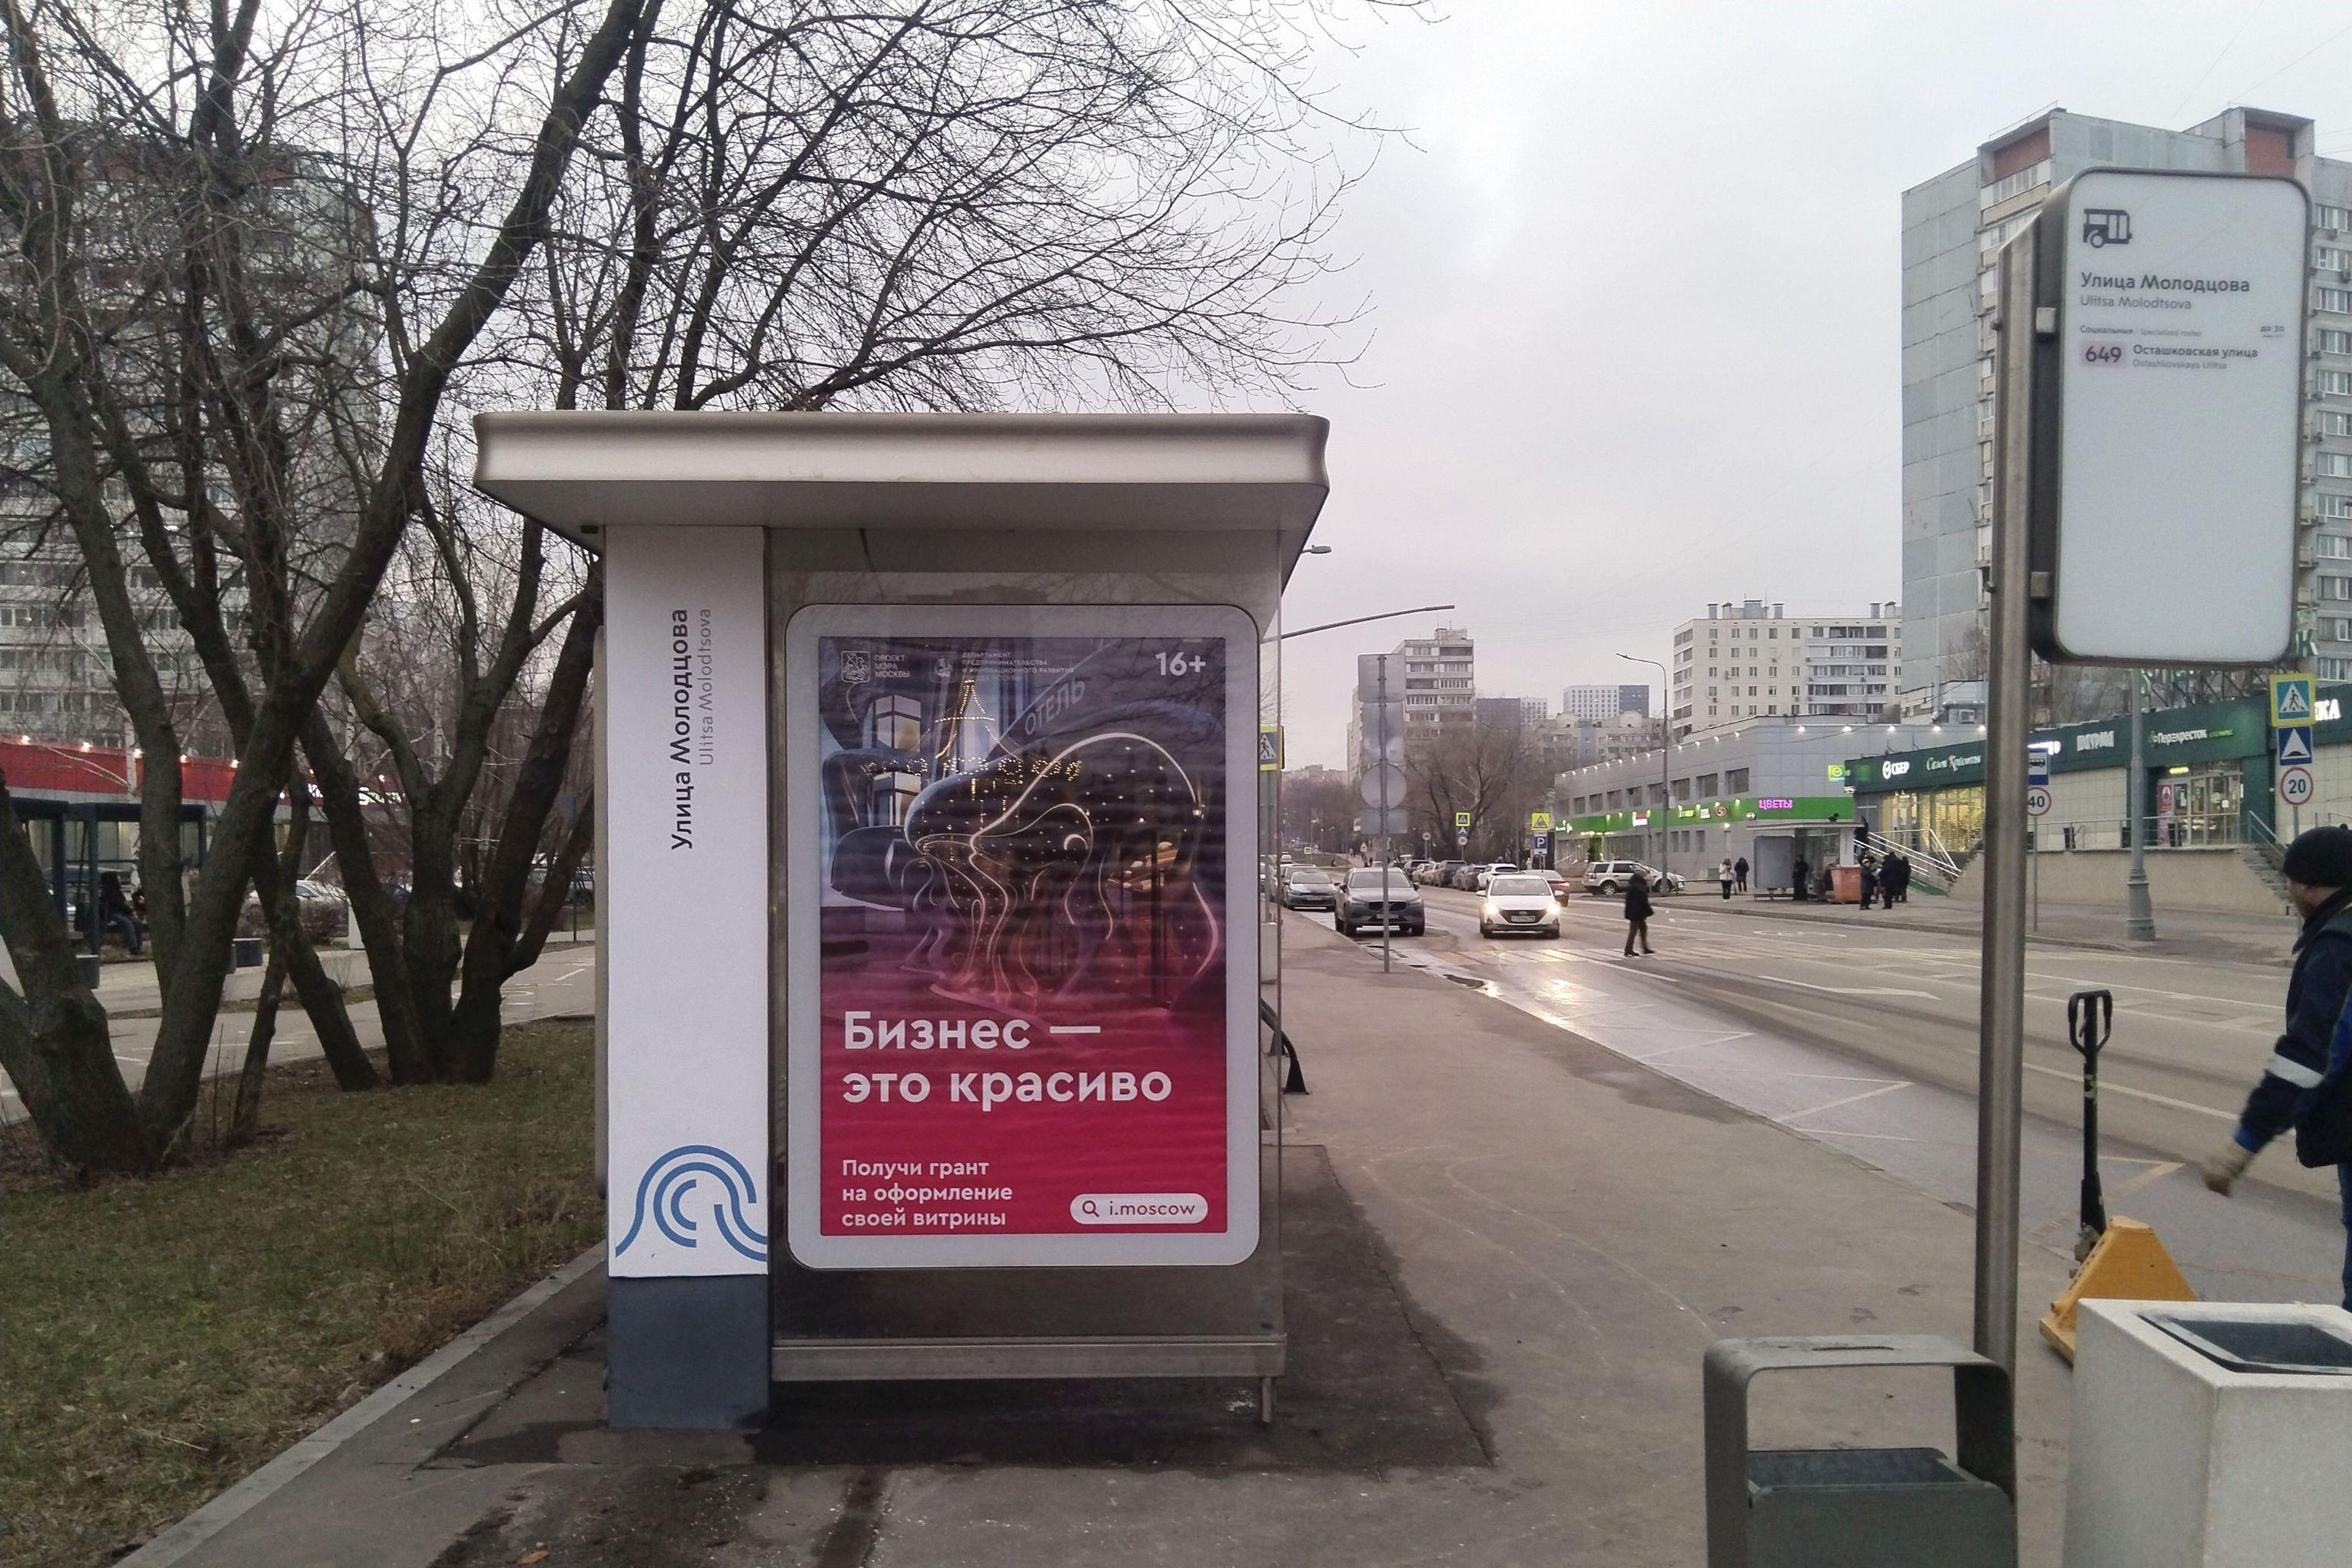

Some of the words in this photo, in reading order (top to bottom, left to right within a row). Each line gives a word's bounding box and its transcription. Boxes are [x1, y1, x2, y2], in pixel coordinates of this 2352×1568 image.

[2081, 271, 2135, 291] Улица
[2140, 274, 2250, 293] Молодцова
[2081, 294, 2114, 307] Ulitsa
[2118, 297, 2191, 309] Molodtsova
[2085, 346, 2121, 363] 649
[2133, 344, 2219, 357] Осташковская
[2221, 349, 2258, 359] улица
[697, 609, 713, 711] Molodtsova
[1155, 652, 1206, 676] 16+
[670, 610, 693, 764] Молодцова
[1025, 679, 1085, 735] ОТЕЛЬ
[699, 716, 714, 765] Ulitsa
[2288, 779, 2307, 794] 20
[671, 772, 694, 849] Улица
[1759, 799, 1793, 810] ЦВЕТЫ
[2028, 796, 2045, 808] 40
[845, 1011, 1031, 1050] Бизнес
[842, 1072, 931, 1103] это
[950, 1071, 1172, 1112] красиво
[842, 1159, 922, 1179] Получи
[929, 1162, 989, 1179] грант
[842, 1188, 866, 1201] на
[874, 1182, 1013, 1204] оформление
[842, 1207, 906, 1227] своей
[913, 1212, 1006, 1229] витрины
[1110, 1201, 1195, 1216] i.moscow
